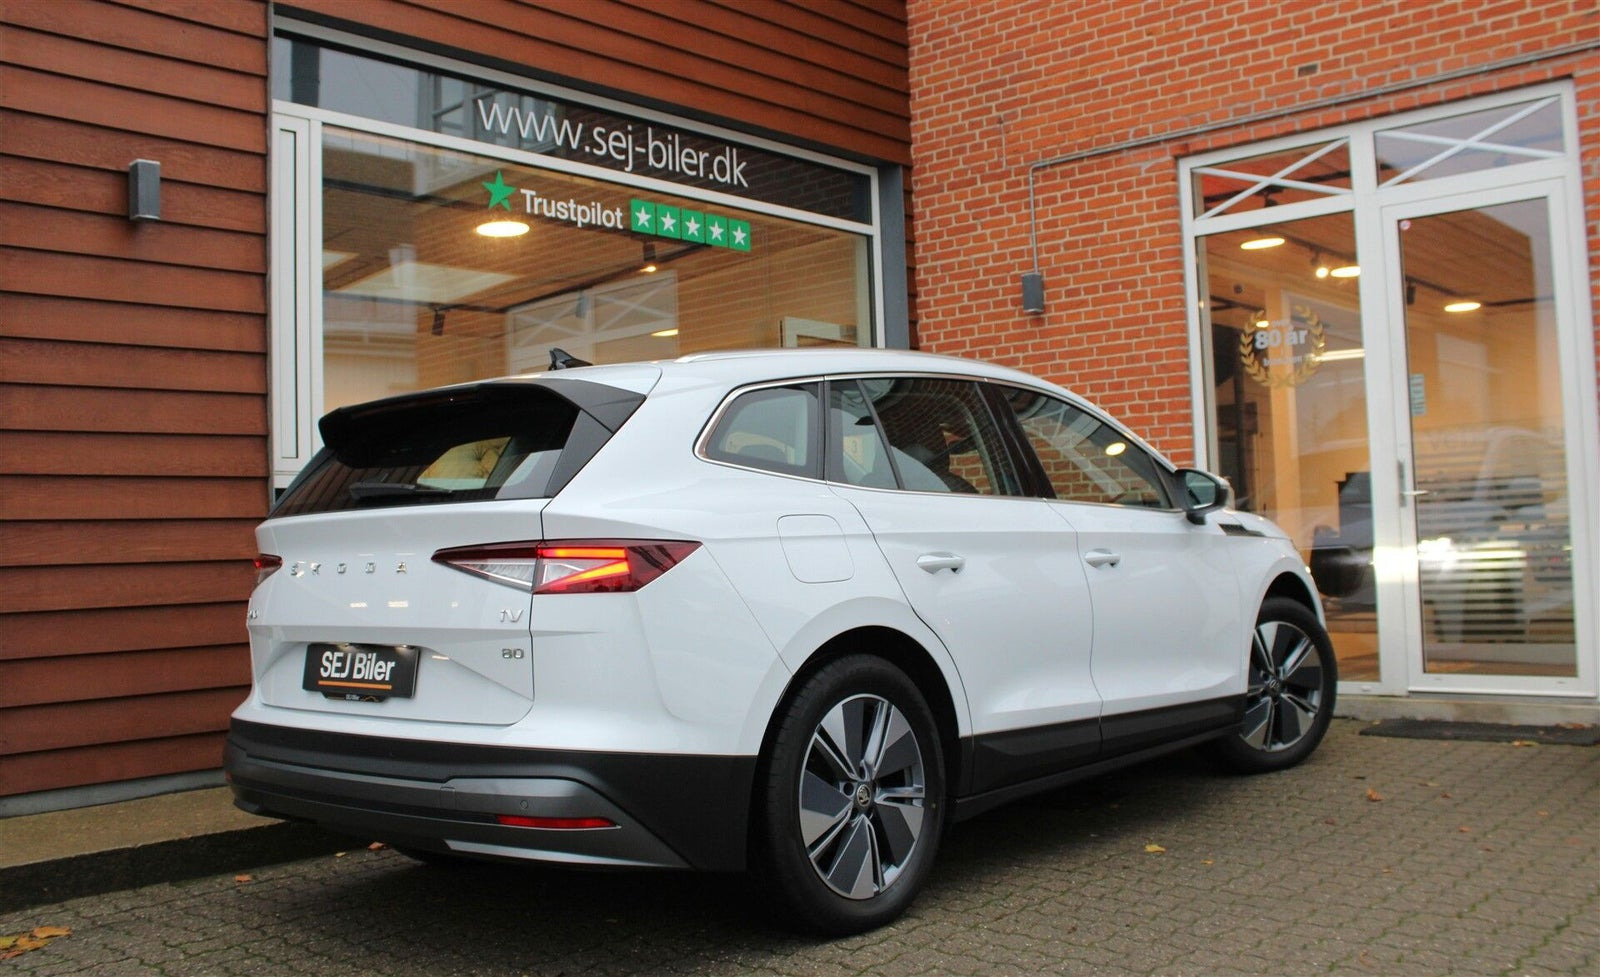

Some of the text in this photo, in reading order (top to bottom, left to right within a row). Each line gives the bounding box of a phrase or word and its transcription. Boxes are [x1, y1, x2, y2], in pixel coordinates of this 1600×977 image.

[477, 98, 749, 188] www.sej-biler.dk
[520, 188, 624, 230] Trustpilot
[1254, 329, 1281, 350] 80
[320, 651, 396, 681] SEJ Biler
[501, 648, 525, 660] 80
